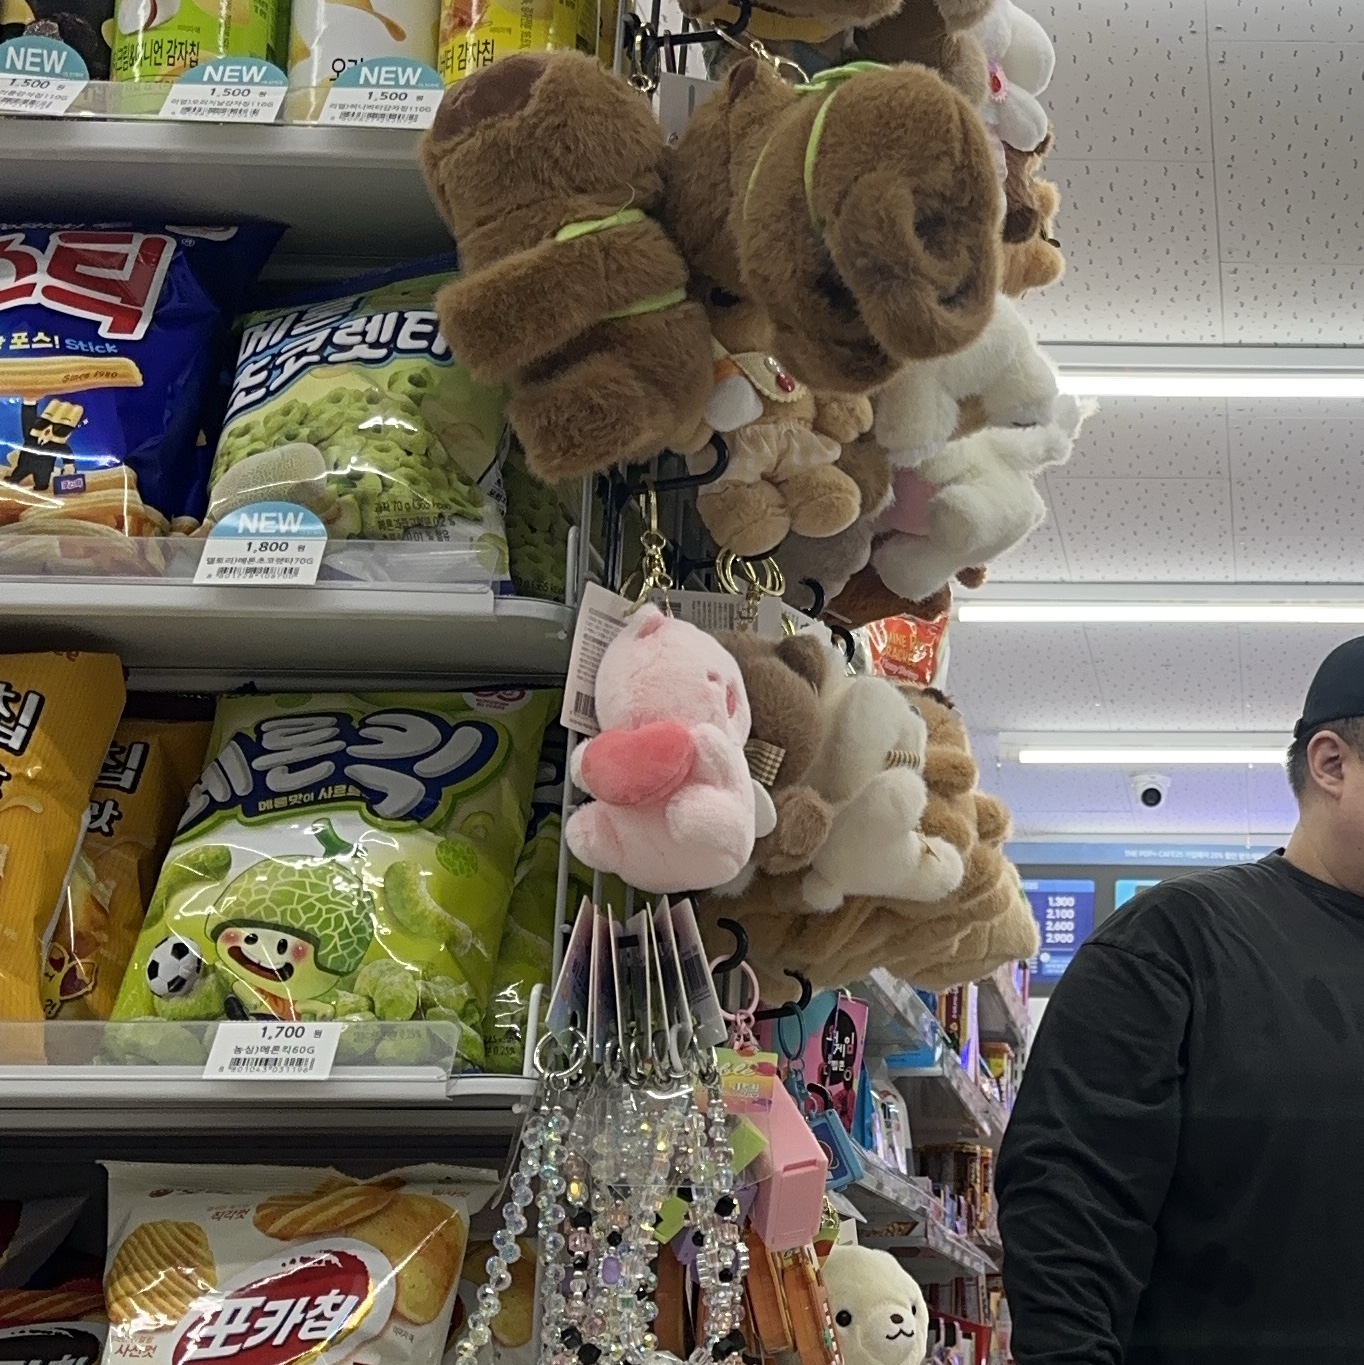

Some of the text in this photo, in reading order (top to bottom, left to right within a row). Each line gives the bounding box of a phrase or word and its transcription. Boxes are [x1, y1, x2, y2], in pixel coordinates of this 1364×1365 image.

[5, 46, 67, 74] NEW
[165, 39, 200, 67] 감자칩
[203, 66, 267, 83] NEW
[358, 66, 422, 86] NEW
[9, 79, 51, 90] 1,500
[209, 87, 250, 98] 1,500
[366, 91, 408, 101] 1,500
[65, 339, 118, 353] Stick
[238, 512, 305, 534] NEW
[245, 542, 289, 553] 1,800
[260, 1026, 306, 1041] 1,700
[188, 1286, 360, 1361] 포카칩
